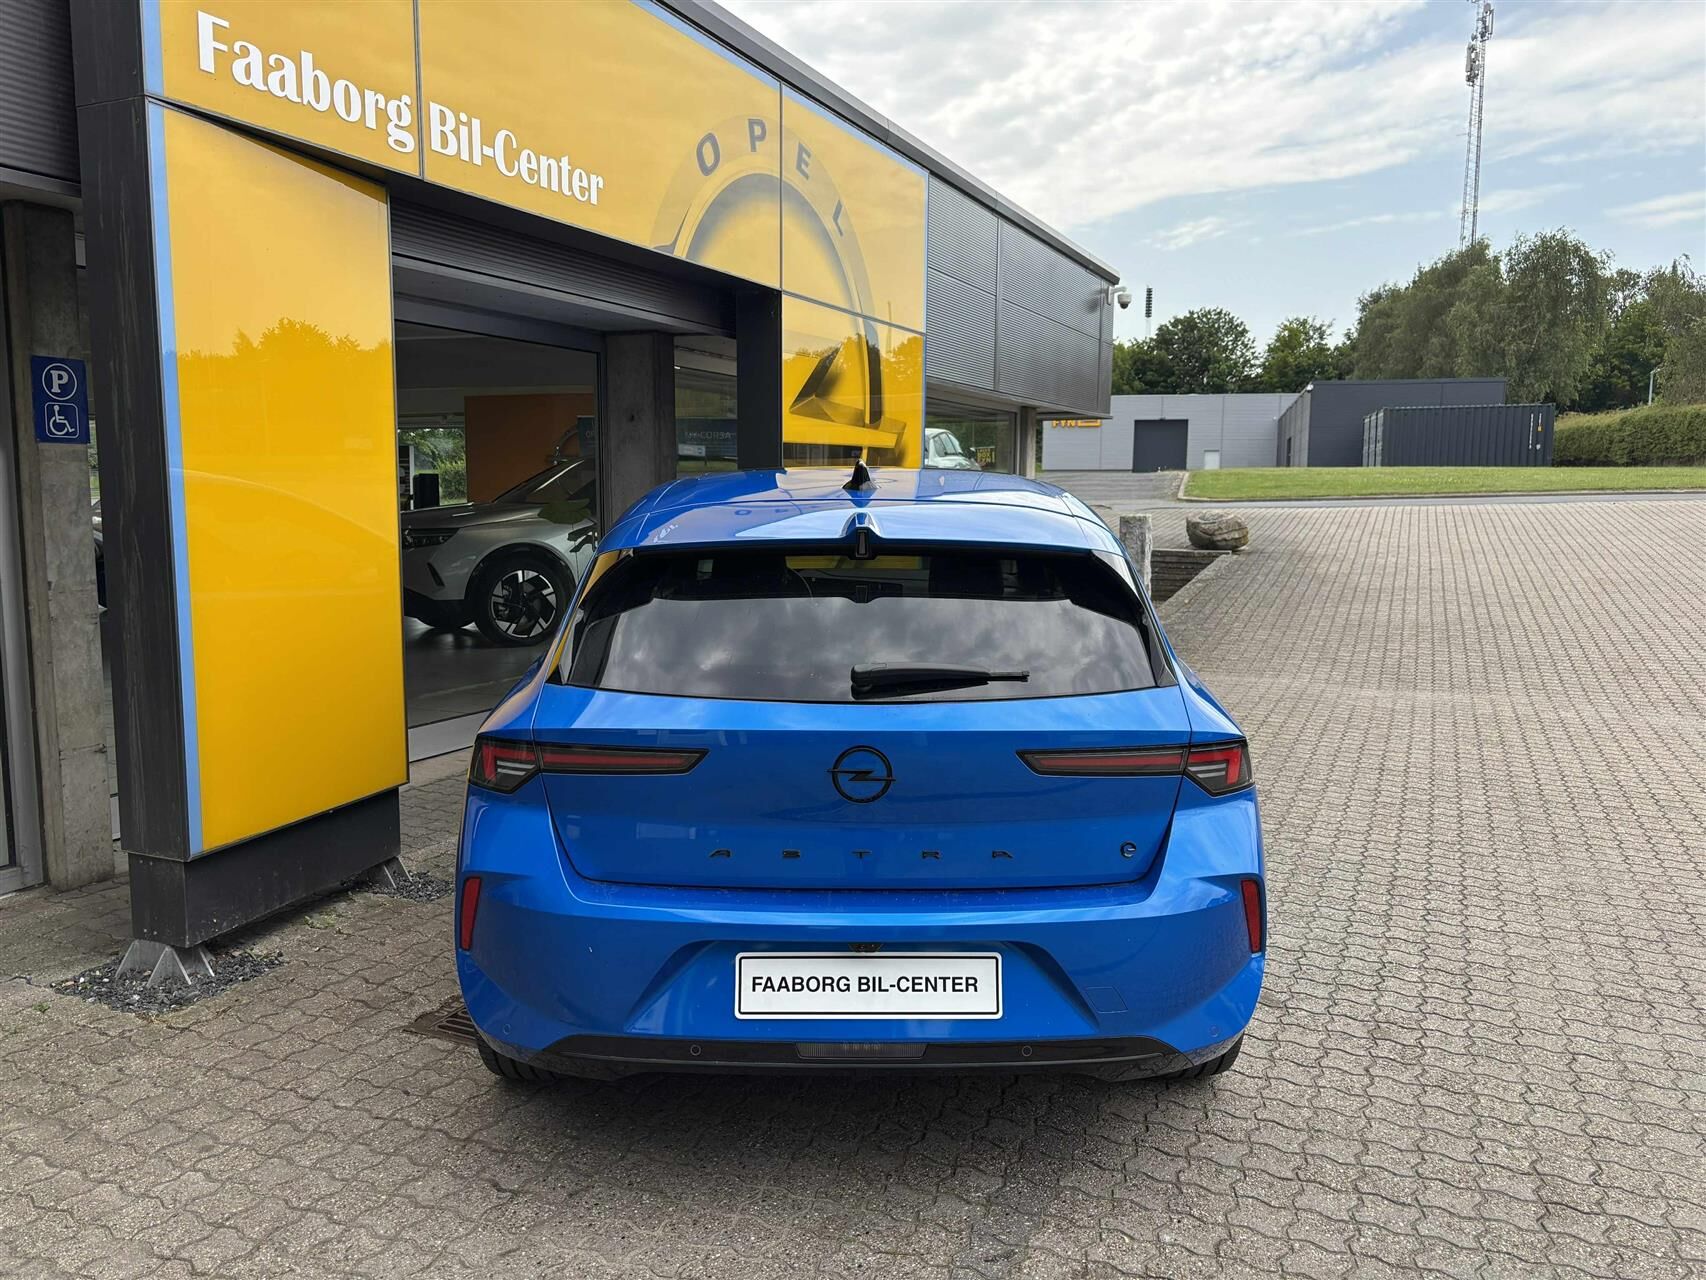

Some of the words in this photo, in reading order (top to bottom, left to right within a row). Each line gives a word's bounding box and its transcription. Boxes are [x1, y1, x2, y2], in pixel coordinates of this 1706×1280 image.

[197, 10, 415, 154] Faaborg
[429, 101, 603, 206] Bil-Center
[696, 117, 844, 237] OPEL
[50, 369, 69, 393] P
[709, 849, 1013, 859] ASTRA
[751, 976, 851, 993] FAABORG
[857, 976, 979, 993] BIL-CENTER
